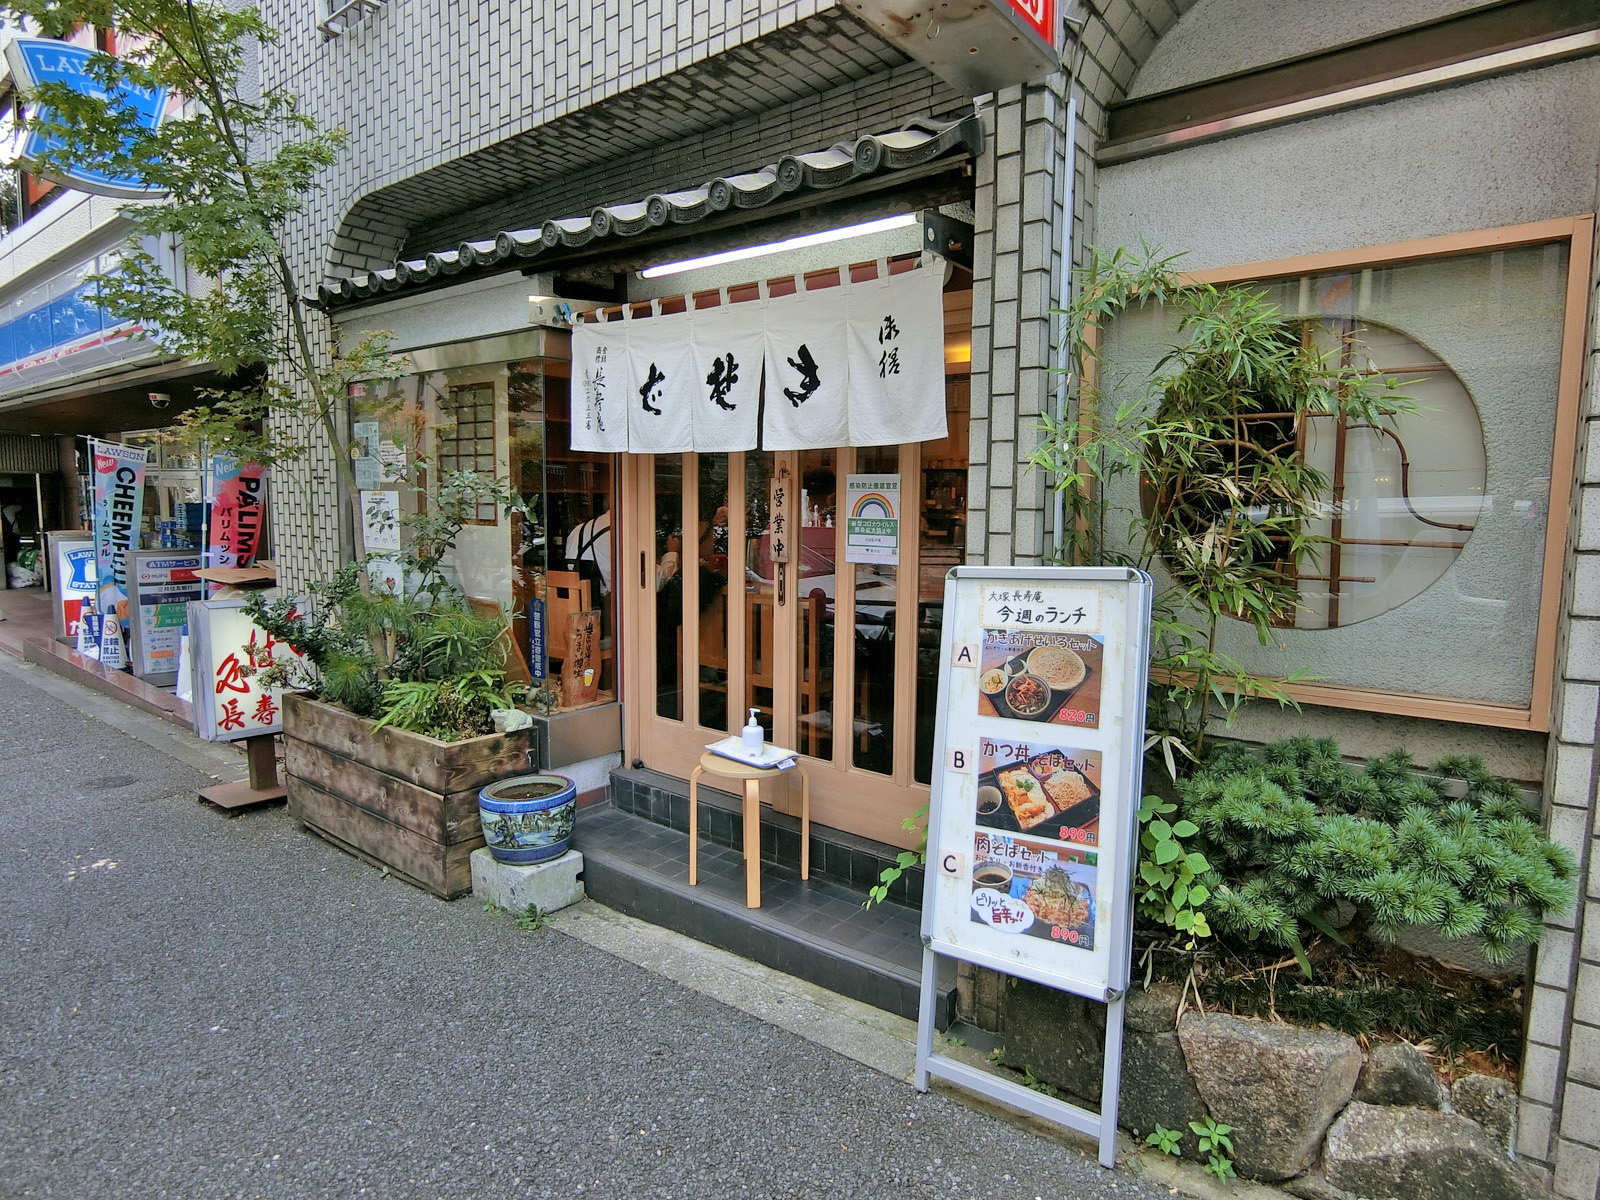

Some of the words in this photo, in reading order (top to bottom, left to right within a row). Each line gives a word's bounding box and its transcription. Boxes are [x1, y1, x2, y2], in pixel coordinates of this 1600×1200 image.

[97, 445, 145, 461] LAWSON
[773, 487, 786, 559] 営業中
[149, 559, 198, 569] ATMサービス
[988, 589, 1044, 604] 大塚長寿庵
[996, 605, 1087, 625] 今週のランチ
[986, 632, 1098, 651] かきあげせいろセット
[957, 646, 972, 663] A
[1058, 708, 1096, 723] 820円
[953, 750, 966, 769] B
[983, 740, 1031, 761] かつ丼
[1037, 752, 1096, 772] そばセット
[1058, 826, 1096, 843] 890円
[976, 837, 1051, 863] 肉そばセット
[943, 854, 957, 873] C
[976, 892, 1006, 907] ピリッと
[1051, 925, 1090, 947] 890円
